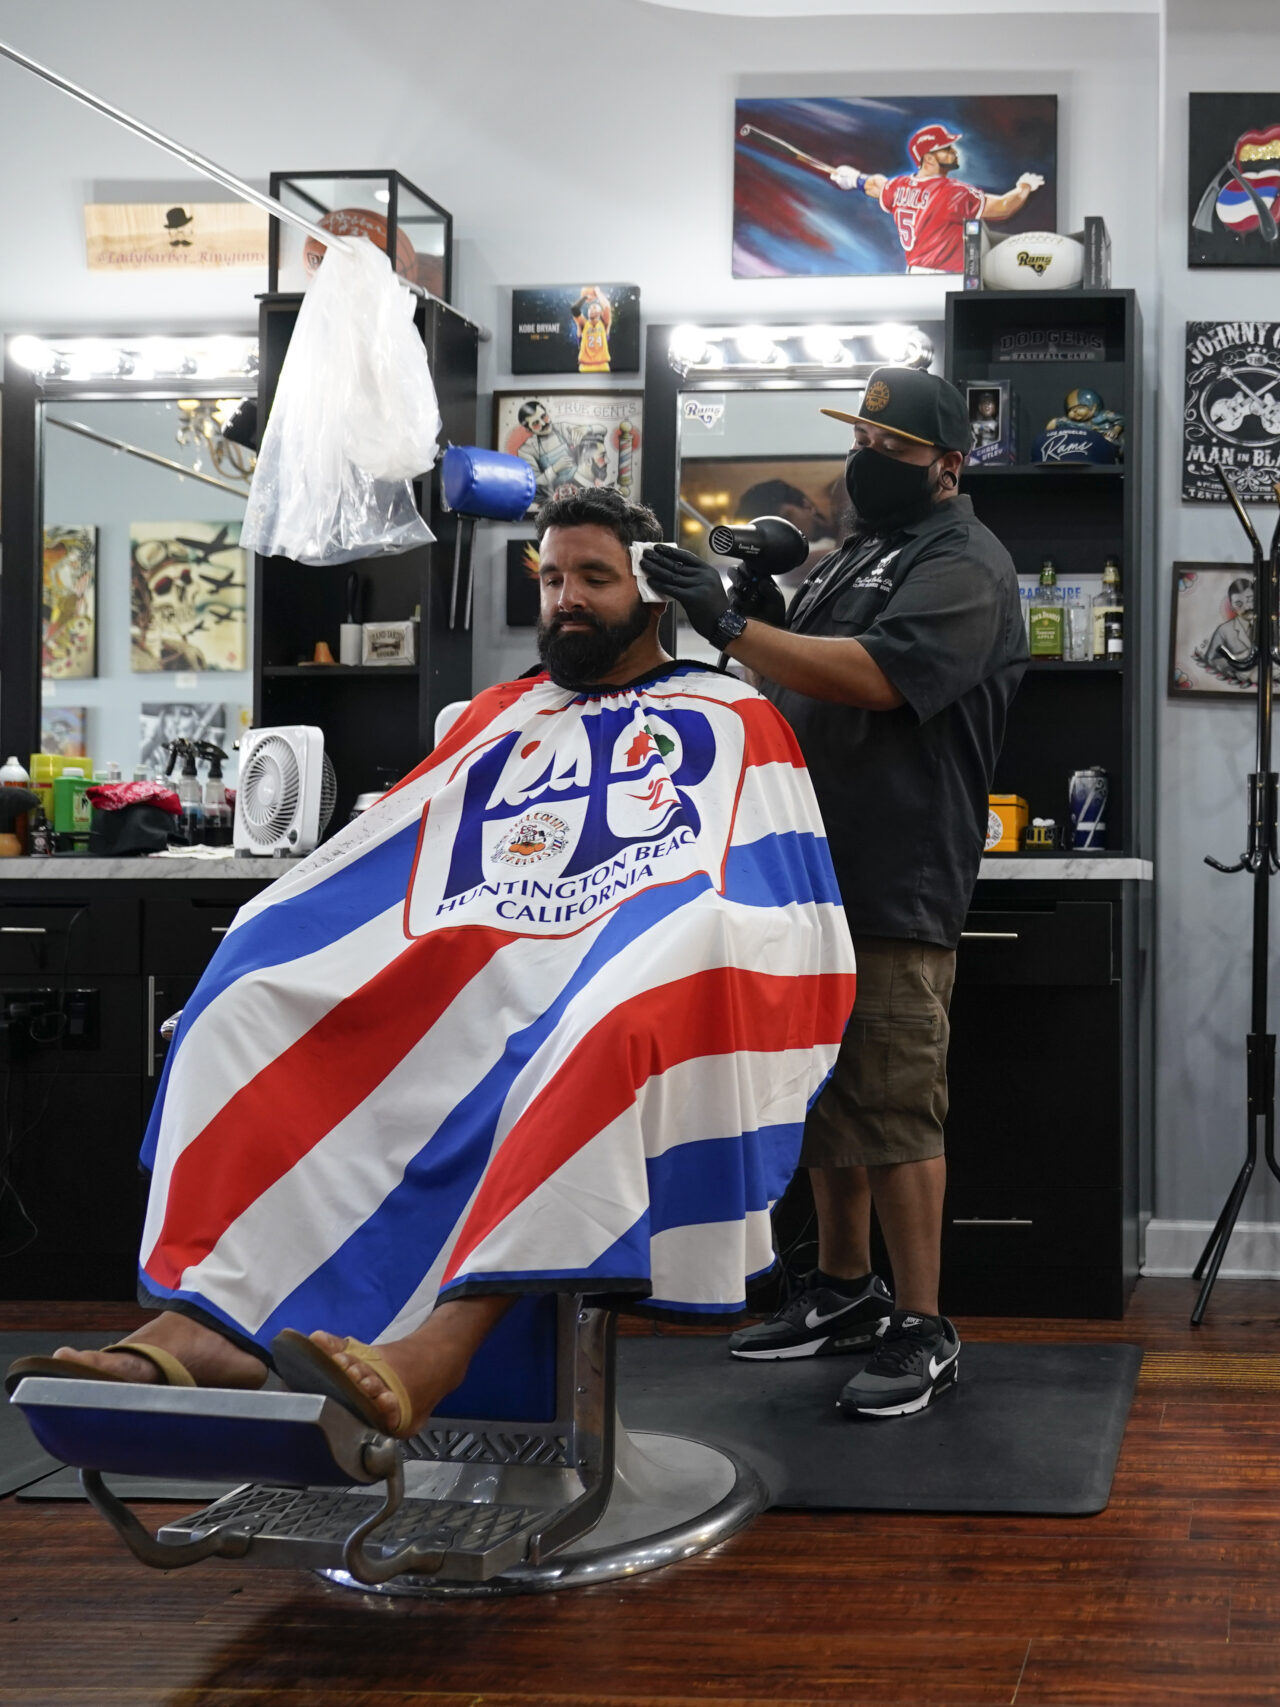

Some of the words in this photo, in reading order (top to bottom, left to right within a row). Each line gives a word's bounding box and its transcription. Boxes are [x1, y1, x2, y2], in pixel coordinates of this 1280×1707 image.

[898, 208, 916, 251] 5
[1016, 251, 1052, 273] Rams
[519, 323, 535, 334] KOBE
[536, 323, 560, 334] BRYANT
[588, 336, 603, 348] 24
[1000, 331, 1103, 350] DODGERS
[1188, 322, 1271, 365] JOHNNY
[554, 402, 591, 416] TRUE
[593, 401, 637, 418] GENTS
[1041, 434, 1093, 462] Rams
[1186, 444, 1236, 466] MAN
[1237, 453, 1250, 463] IN
[435, 852, 627, 916] HUNTINGTON
[496, 864, 653, 923] CALIFORNIA
